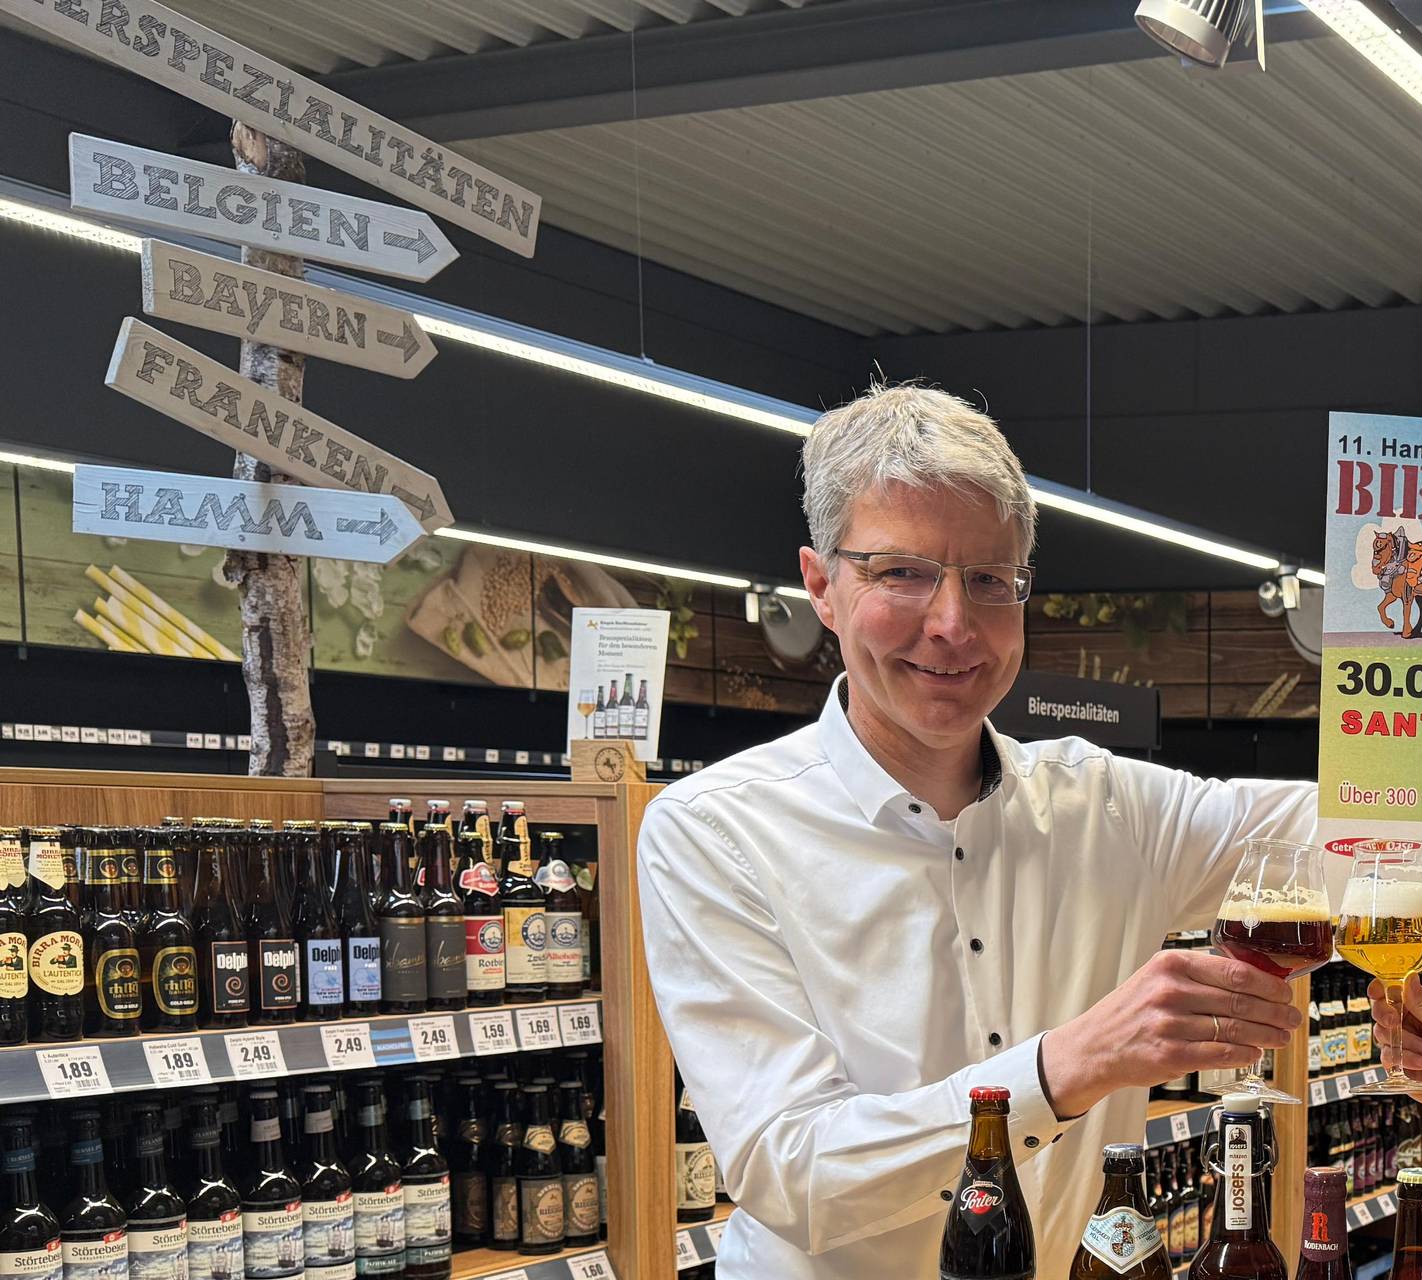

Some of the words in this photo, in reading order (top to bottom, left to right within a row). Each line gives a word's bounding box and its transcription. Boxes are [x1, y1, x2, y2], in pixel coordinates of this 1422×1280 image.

[93, 152, 371, 252] BELGIEN
[168, 259, 367, 349] BAYERN
[136, 339, 390, 497] FRANKEN
[1338, 434, 1372, 456] 11.
[101, 481, 324, 541] HAMM
[1028, 697, 1120, 724] Bierspezialitäten
[1339, 782, 1381, 805] Über
[1386, 788, 1417, 807] 300
[483, 1024, 505, 1039] 1,59
[528, 1020, 550, 1034] 1,69
[570, 1016, 590, 1030] 1,69
[335, 1037, 362, 1053] 2,49
[421, 1030, 447, 1045] 2,49
[162, 1052, 194, 1070] 1,89
[241, 1045, 272, 1062] 2,49
[58, 1062, 92, 1079] 1,89
[960, 1189, 1000, 1211] Porter
[1304, 1239, 1338, 1251] RODENBACH
